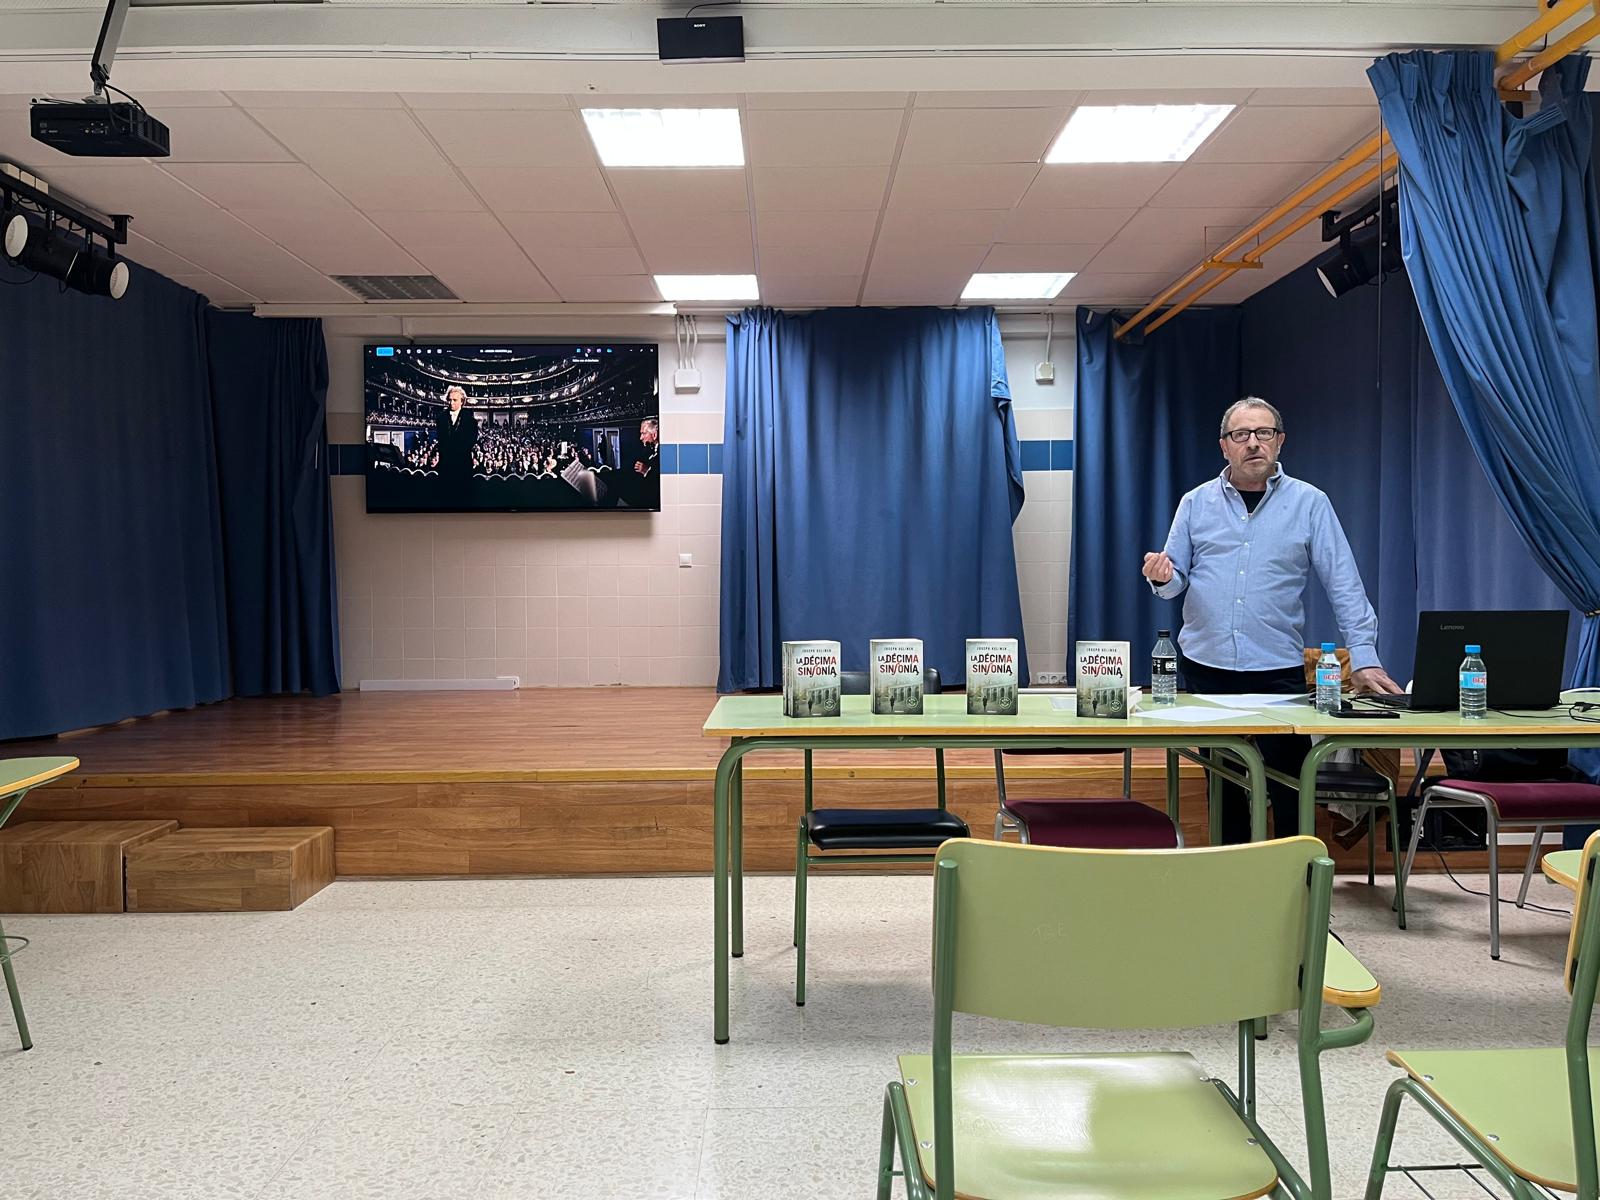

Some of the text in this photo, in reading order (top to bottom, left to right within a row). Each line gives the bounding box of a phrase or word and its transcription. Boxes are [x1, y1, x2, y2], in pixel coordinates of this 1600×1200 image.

[802, 655, 837, 666] DÉCIMA
[884, 653, 919, 664] DÉCIMA
[977, 653, 1013, 664] DÉCIMA
[1086, 654, 1123, 666] DÉCIMA
[797, 665, 837, 677] SINFONÍA
[880, 663, 920, 676] SINFONÍA
[972, 663, 1013, 676] SINFONÍA
[1081, 665, 1123, 678] SINFONÍA
